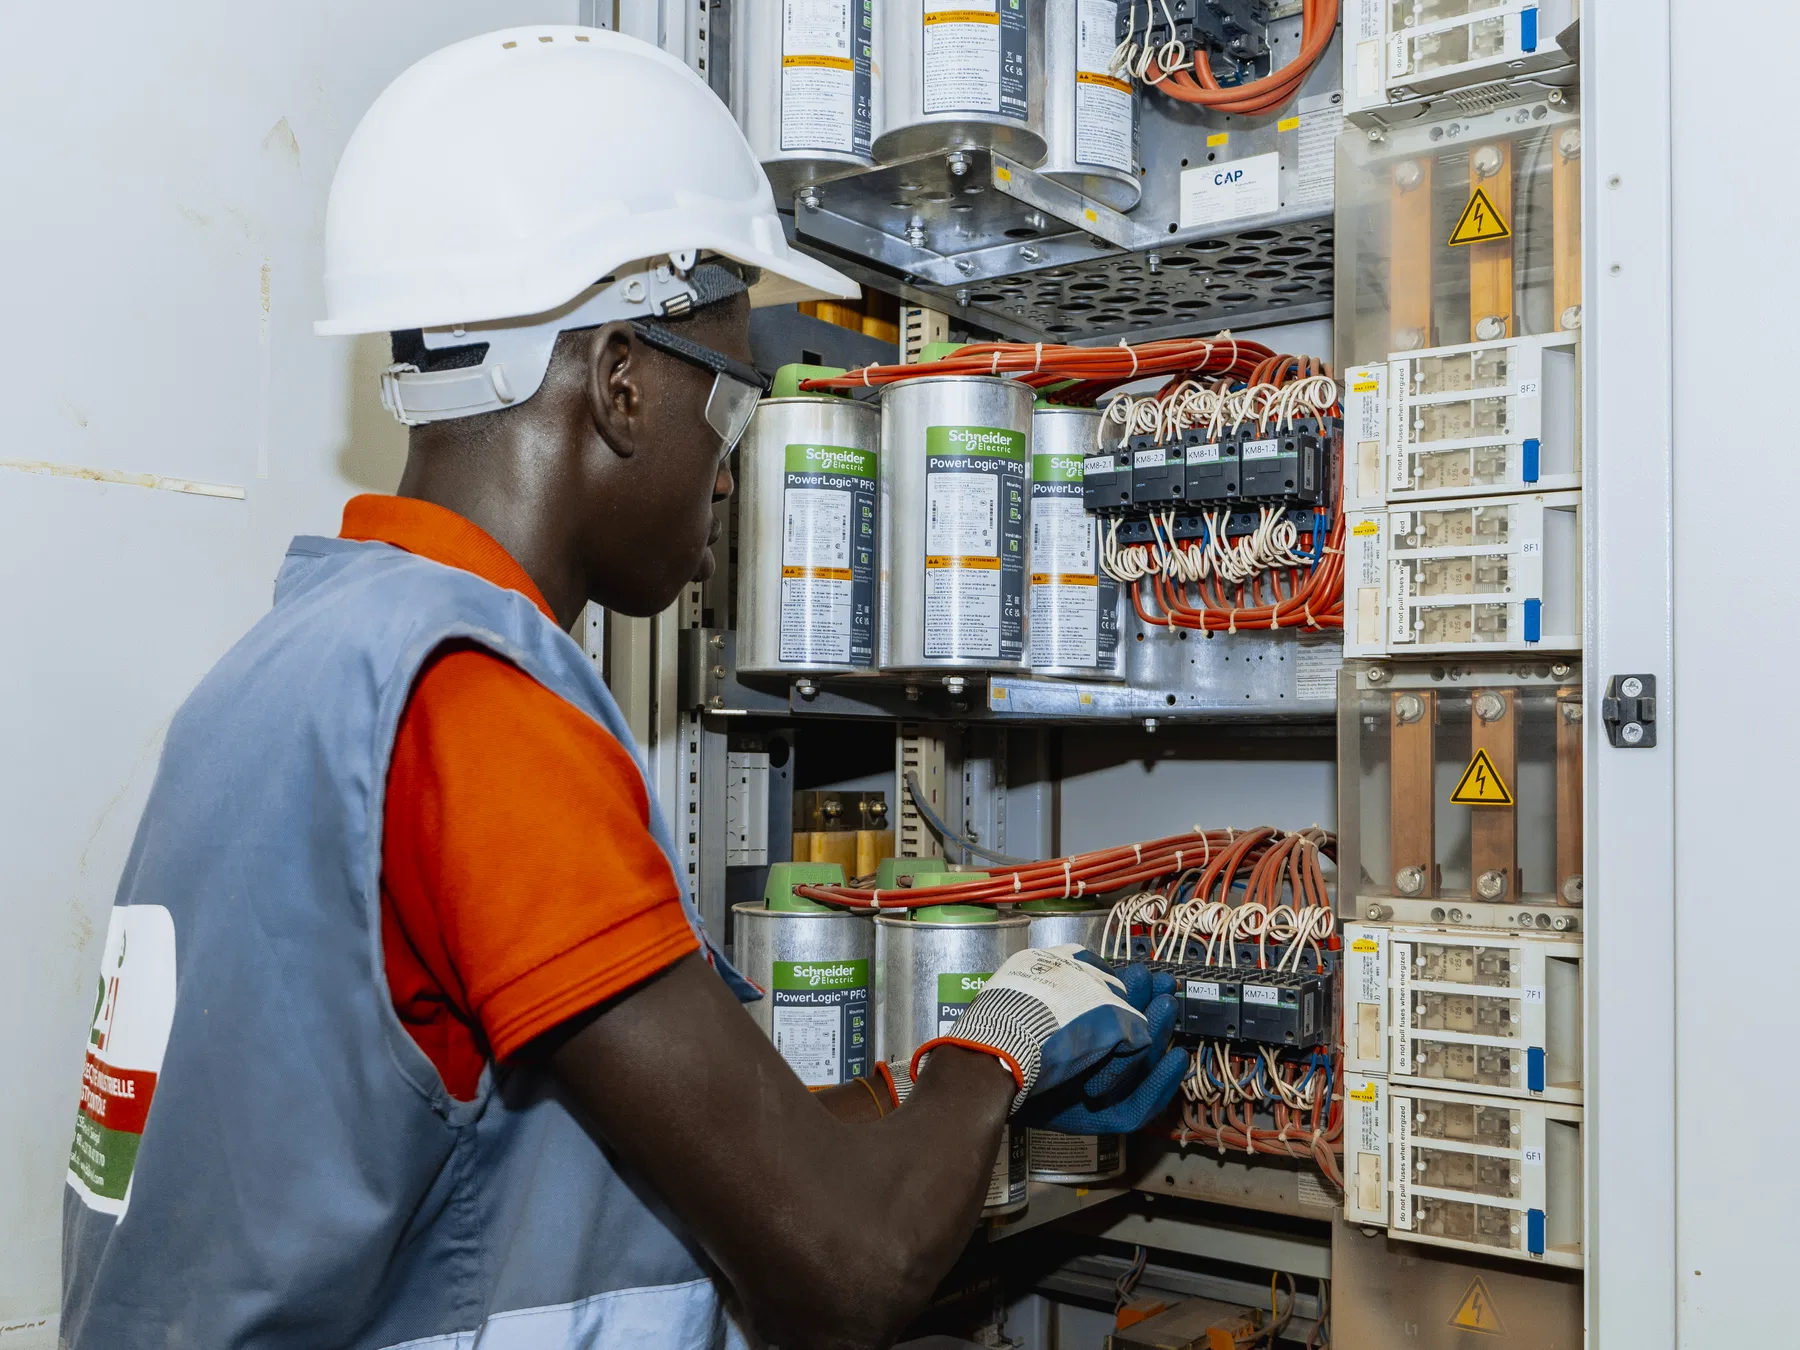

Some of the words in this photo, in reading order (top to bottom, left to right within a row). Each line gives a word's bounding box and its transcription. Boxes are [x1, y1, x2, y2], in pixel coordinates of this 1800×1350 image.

[1397, 59, 1402, 68] do
[1214, 170, 1243, 186] CAP
[1521, 384, 1535, 393] 8F2
[949, 430, 1012, 446] Schneider
[978, 443, 1011, 453] Electric
[1245, 444, 1276, 454] KM8-1.2
[806, 448, 865, 464] Schneider
[1136, 454, 1164, 463] KM8-2.2
[1188, 449, 1217, 459] KM8-1.1
[833, 461, 863, 472] Electric
[1008, 462, 1023, 474] PFC
[1085, 461, 1112, 470] KM8-2.1
[1397, 472, 1402, 481] do
[860, 480, 874, 491] PFC
[1524, 544, 1538, 552] 8F1
[1398, 626, 1403, 635] do
[793, 965, 855, 977] Schneider
[961, 977, 987, 990] Sch
[850, 989, 866, 1000] PFC
[1188, 987, 1217, 996] KM7-1.1
[1245, 989, 1276, 999] KM7-1.2
[1526, 990, 1540, 999] 7F1
[1400, 1057, 1405, 1067] do
[1526, 1152, 1540, 1160] 6F1
[1400, 1212, 1405, 1222] do
